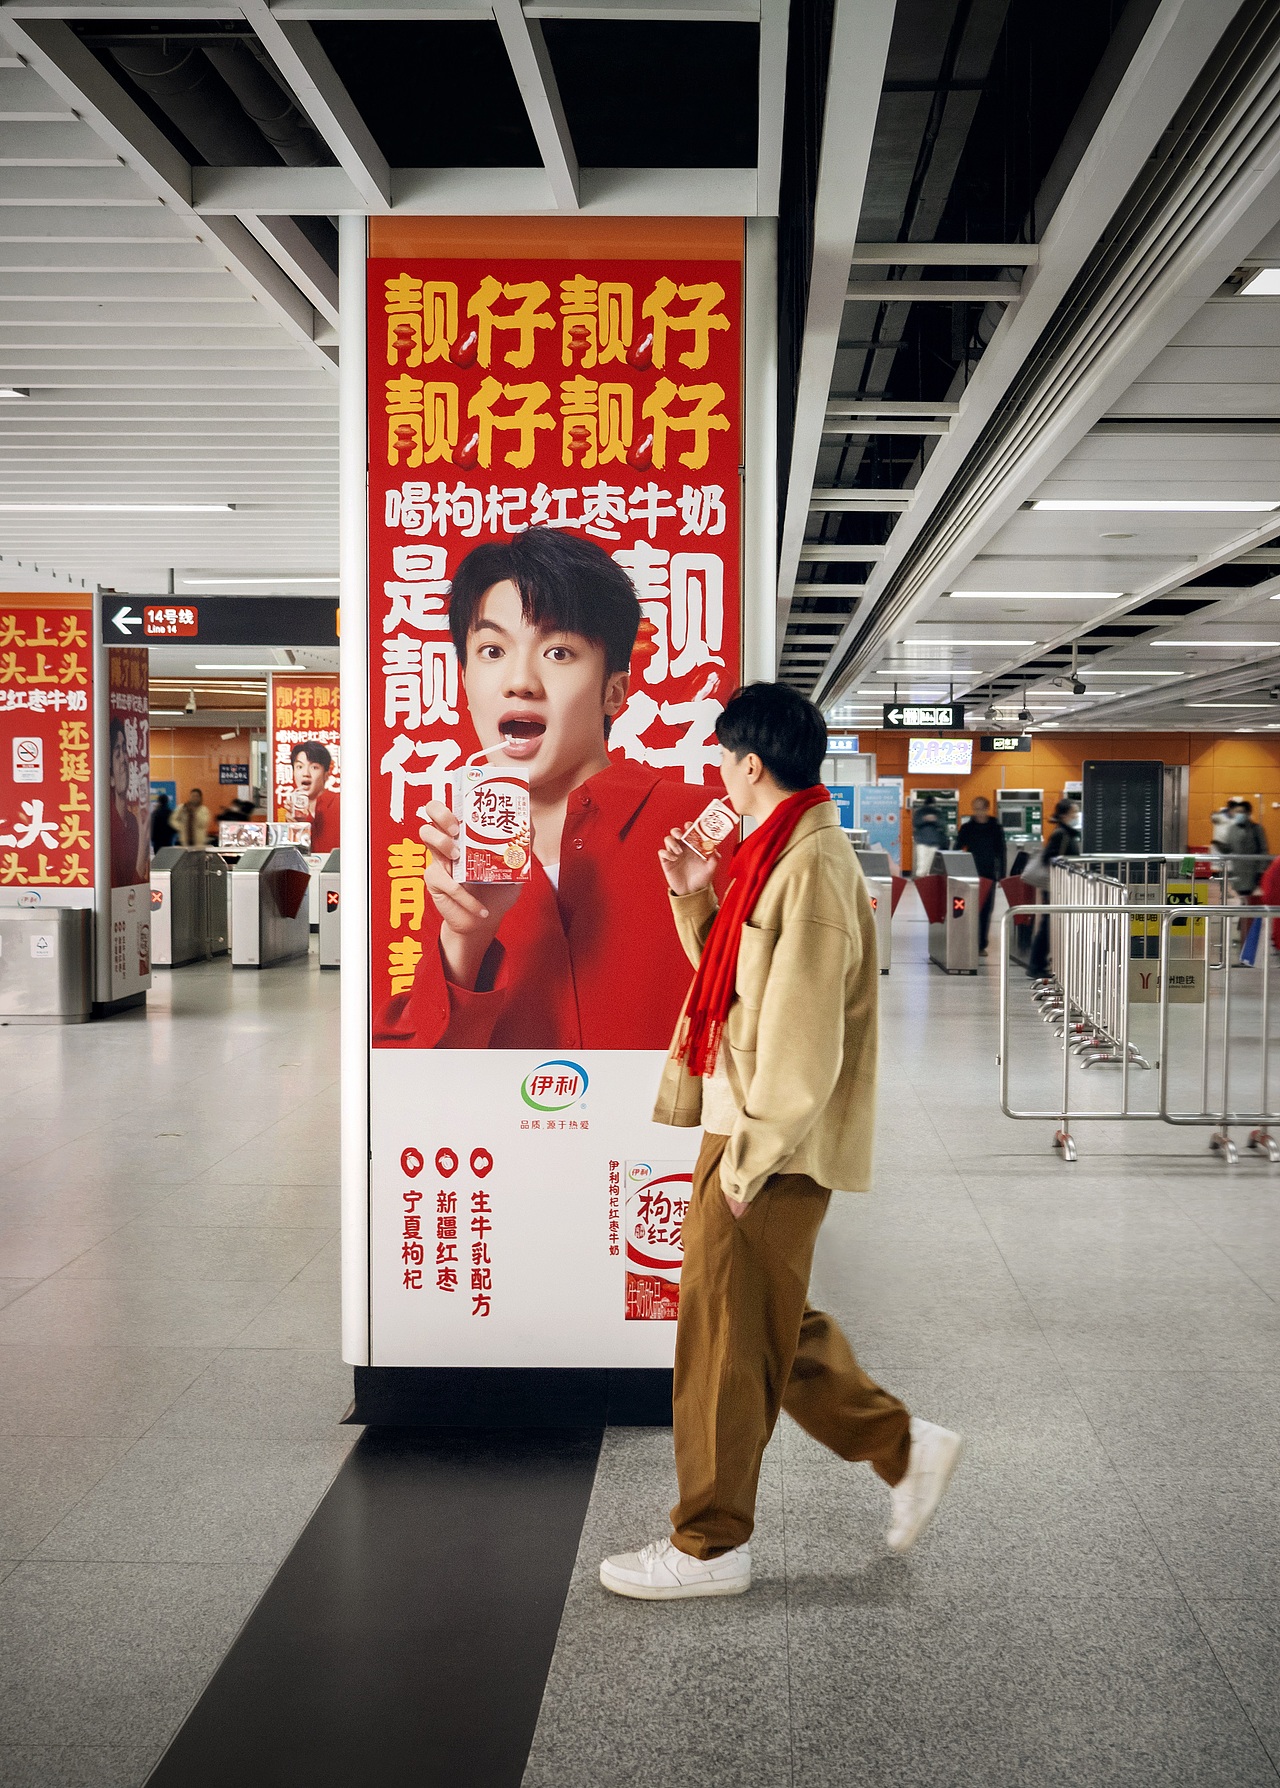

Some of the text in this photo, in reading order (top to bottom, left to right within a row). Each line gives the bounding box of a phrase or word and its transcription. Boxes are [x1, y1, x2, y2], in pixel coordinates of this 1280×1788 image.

[384, 272, 731, 371] 靓仔靓仔
[385, 373, 731, 471] 靓仔靓仔
[385, 480, 726, 540] 喝枸杞红枣牛奶
[0, 615, 88, 648] 头上头
[148, 609, 194, 624] 14号线
[148, 625, 177, 633] Line 14
[0, 652, 88, 684] 头上头
[380, 545, 463, 824] 是靓仔
[608, 546, 724, 784] 靓仔
[58, 720, 91, 850] 还挺上头
[474, 787, 513, 812] 枸杞
[480, 808, 520, 834] 红枣
[0, 853, 89, 885] 头上头
[530, 1075, 579, 1096] 伊利
[631, 1168, 649, 1176] 伊利
[609, 1160, 620, 1256] 伊利枸杞红枣牛奶
[402, 1190, 424, 1290] 宁夏枸杞
[436, 1190, 459, 1292] 新疆红枣
[470, 1190, 492, 1317] 生牛乳配方
